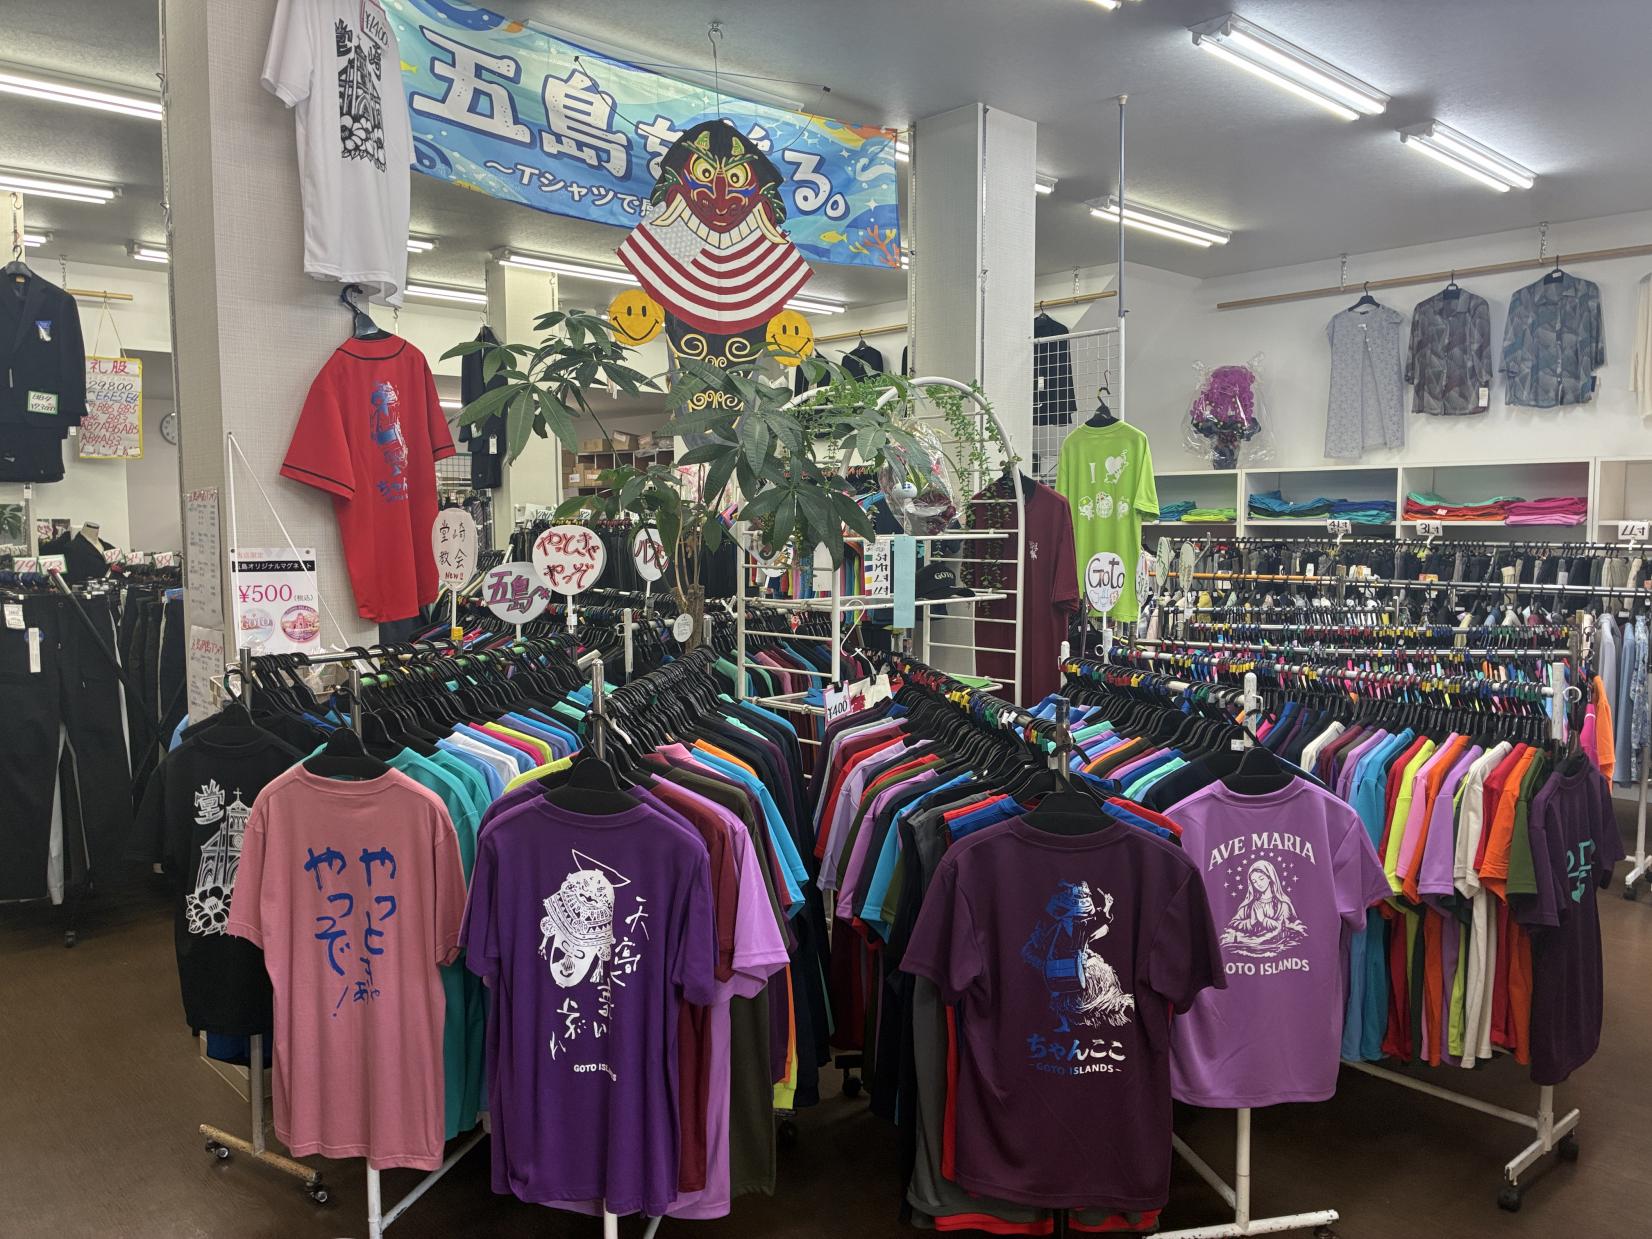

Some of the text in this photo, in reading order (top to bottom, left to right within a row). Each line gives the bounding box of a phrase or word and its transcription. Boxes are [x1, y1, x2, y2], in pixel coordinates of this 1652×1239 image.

[1089, 463, 1096, 483] I
[1087, 557, 1126, 589] Goto
[239, 584, 293, 602] ¥500
[827, 701, 848, 720] ¥400
[1208, 832, 1316, 871] AVE MARIA
[1223, 957, 1311, 976] OTO ISLANDS
[1027, 1032, 1127, 1062] ちゃんここ
[573, 1063, 597, 1073] GOTO
